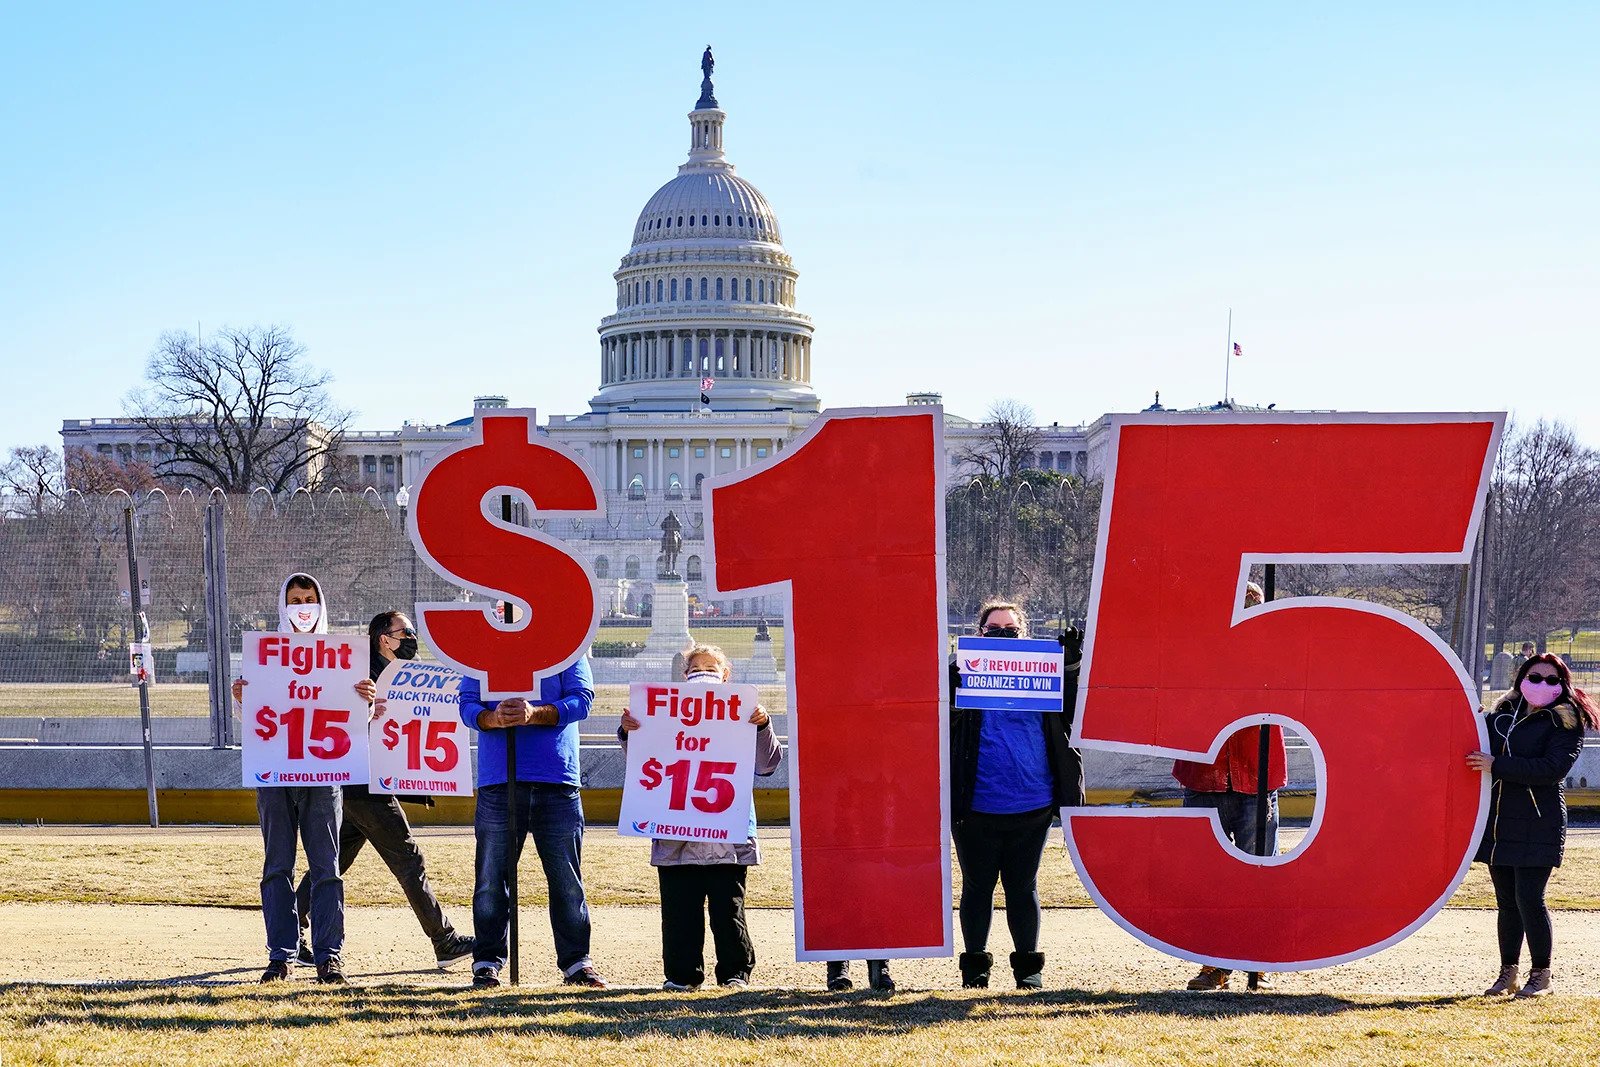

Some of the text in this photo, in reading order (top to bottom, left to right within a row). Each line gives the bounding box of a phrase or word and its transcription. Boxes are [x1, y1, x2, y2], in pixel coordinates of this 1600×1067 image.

[258, 637, 352, 675] Fight
[989, 660, 1057, 673] REVOLUTION
[288, 680, 322, 700] for
[967, 675, 1052, 690] ORGANIZE TO WIN
[387, 690, 460, 704] BACKTRACK
[413, 705, 431, 716] ON
[646, 687, 741, 727] Fight
[255, 706, 351, 760] $15
[675, 731, 711, 752] for
[382, 718, 459, 773] $15
[280, 771, 350, 783] REVOLUTION
[398, 779, 457, 792] REVOLUTION
[639, 757, 737, 814] $15
[656, 824, 728, 840] REVOLUTION
